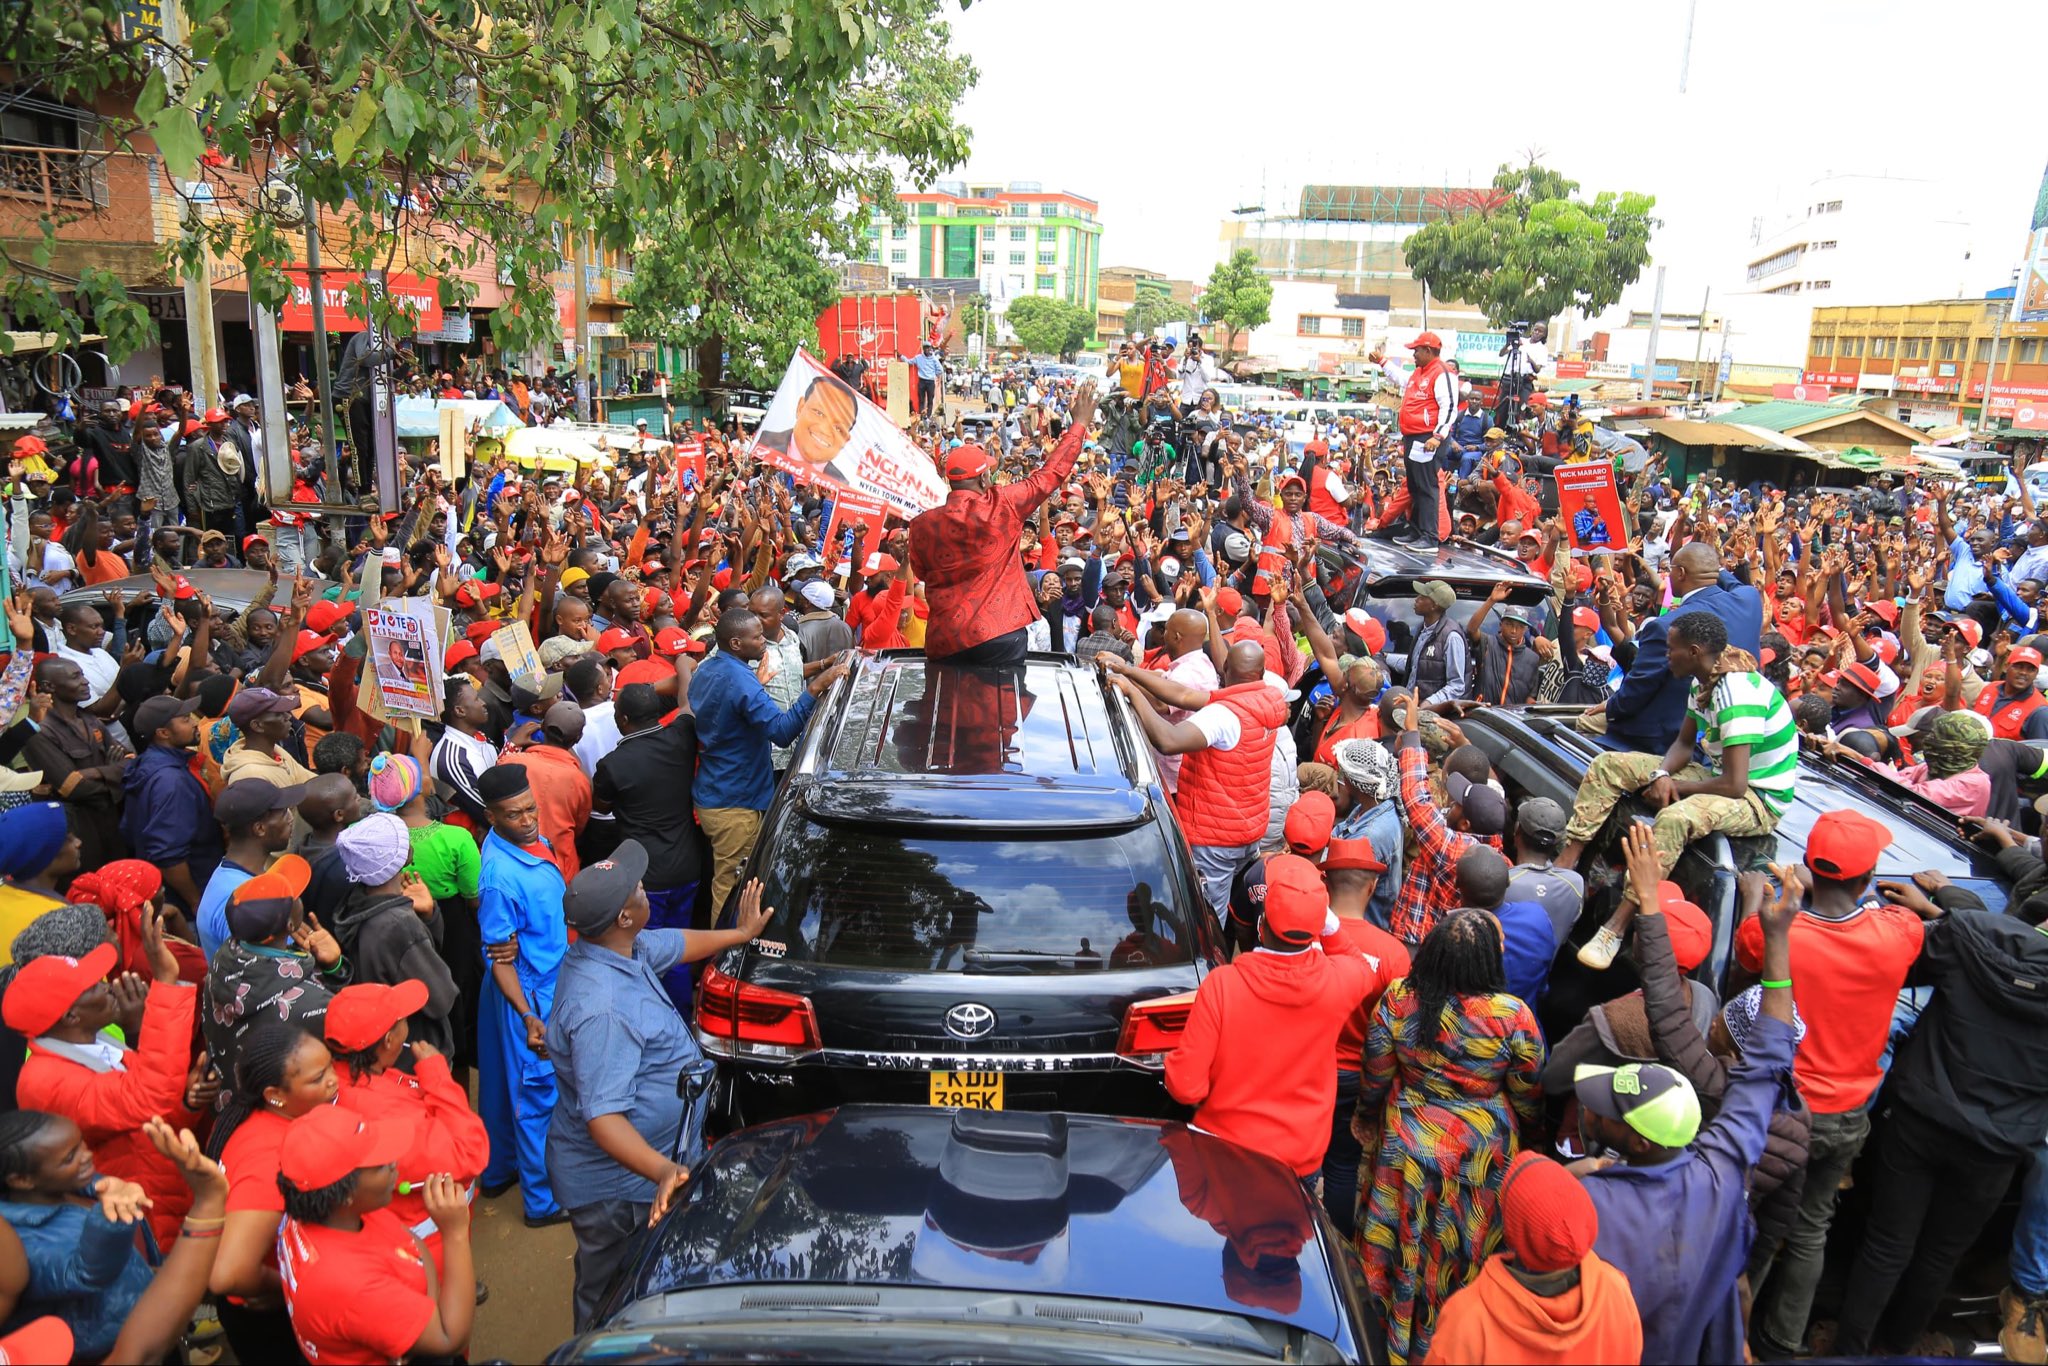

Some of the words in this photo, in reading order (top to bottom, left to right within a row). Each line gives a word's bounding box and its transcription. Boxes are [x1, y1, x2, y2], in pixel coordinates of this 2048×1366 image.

[1577, 467, 1607, 477] MARARO
[881, 490, 904, 505] TOWN
[866, 1054, 931, 1068] LAND
[948, 1071, 999, 1088] KDD
[934, 1091, 998, 1111] 385K
